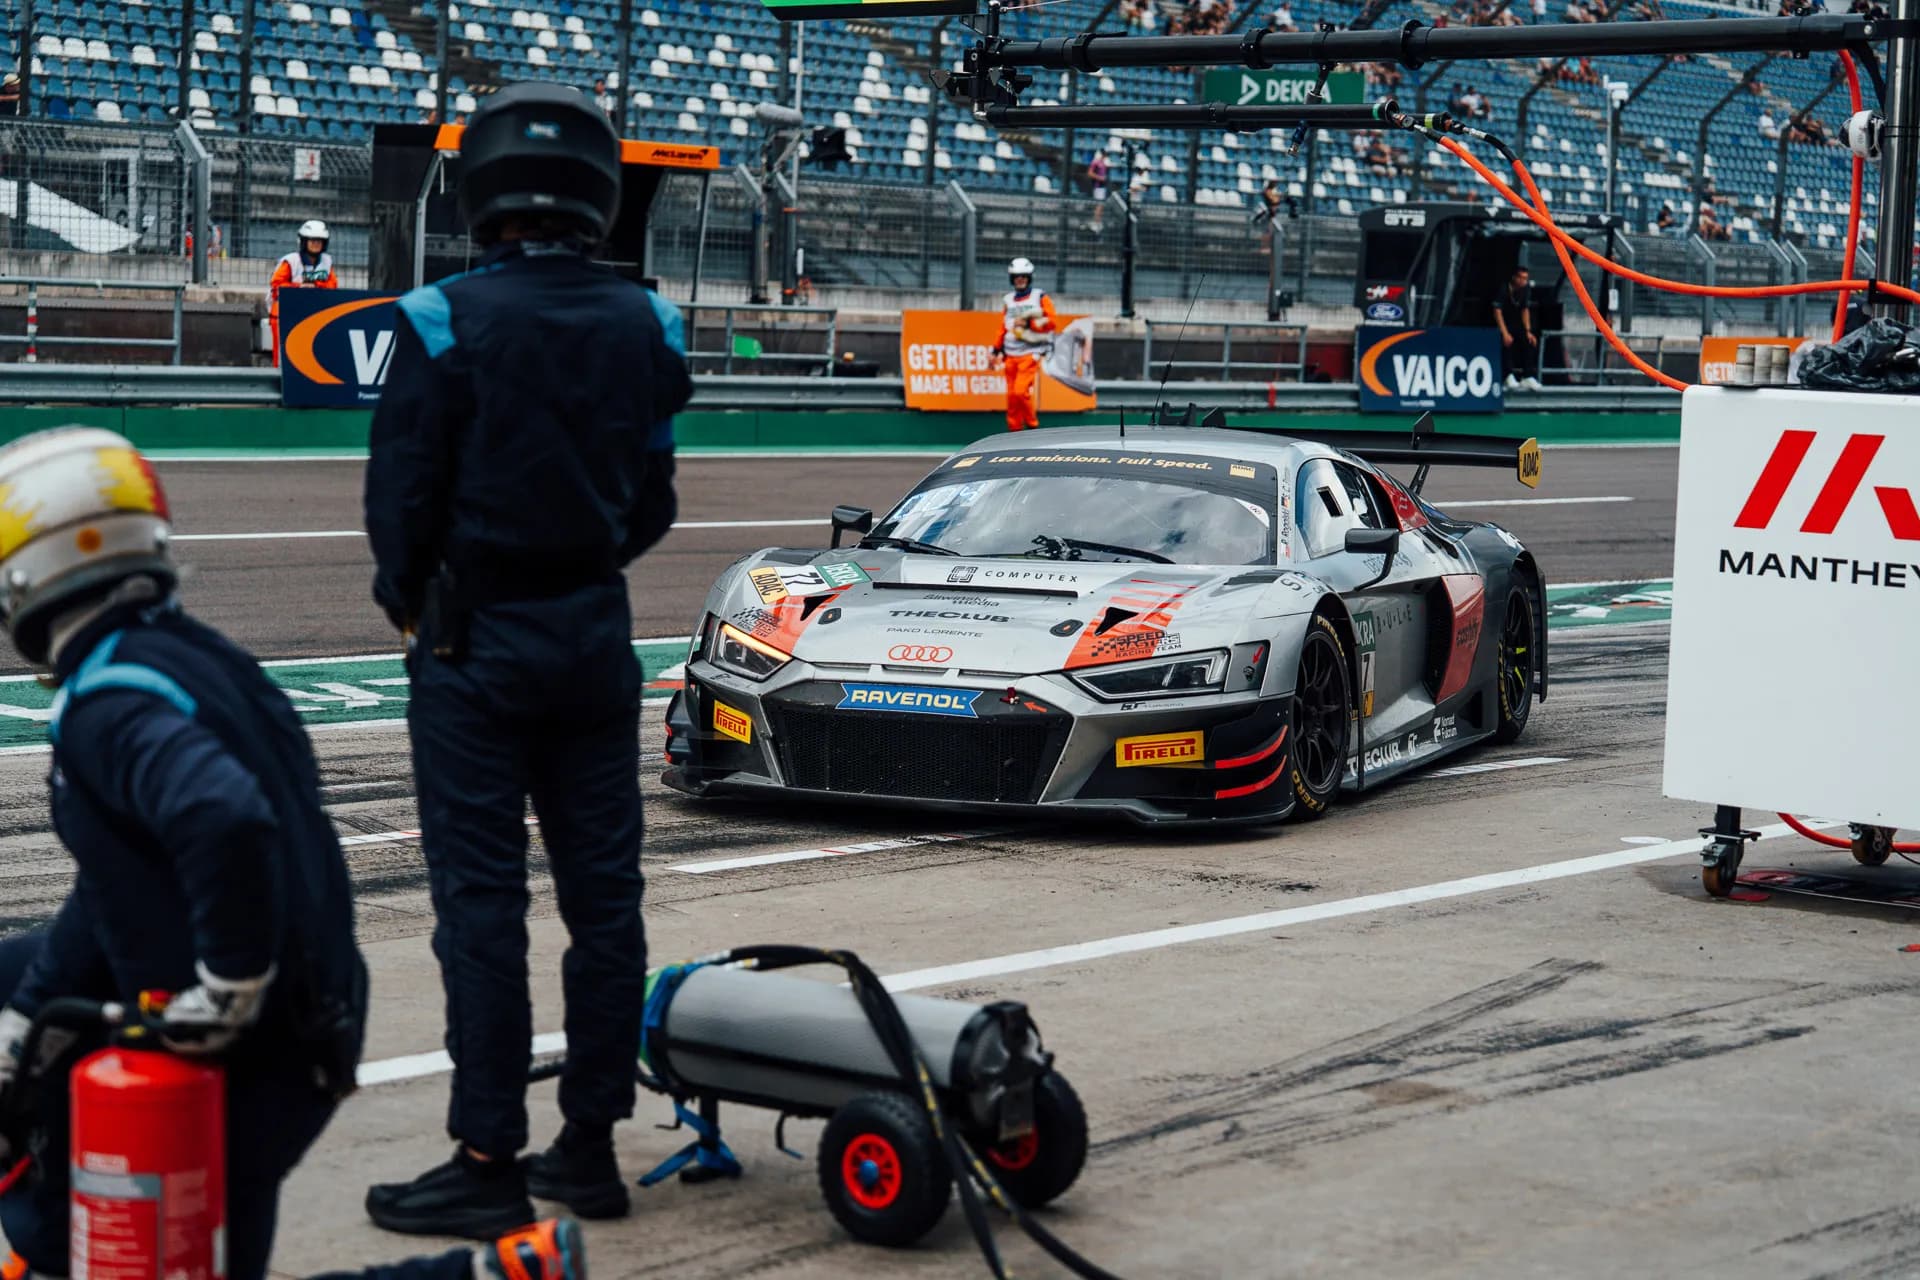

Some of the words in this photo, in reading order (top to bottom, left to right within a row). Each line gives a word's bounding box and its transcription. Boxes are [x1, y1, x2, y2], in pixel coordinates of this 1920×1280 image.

[652, 149, 703, 160] McLaren
[911, 375, 951, 394] MADE
[953, 376, 967, 394] IN
[970, 377, 1008, 395] GERM
[1392, 354, 1493, 398] VAICO
[1116, 457, 1152, 466] Full
[1153, 459, 1213, 471] Speed.
[1522, 451, 1539, 477] ADAC
[781, 572, 825, 586] 77
[822, 562, 863, 586] DEKRA
[985, 570, 1078, 583] COMPUTEX
[753, 573, 785, 596] ADAC
[889, 610, 1010, 622] THECLUB
[924, 629, 984, 638] LORENTE
[1117, 631, 1165, 643] SPEED
[1116, 649, 1152, 658] RACING
[1155, 644, 1182, 652] TEAM
[851, 689, 966, 709] RAVENOL
[716, 708, 747, 737] PIRELLI
[1124, 738, 1196, 761] PIRELLI
[1292, 770, 1318, 809] ZERO
